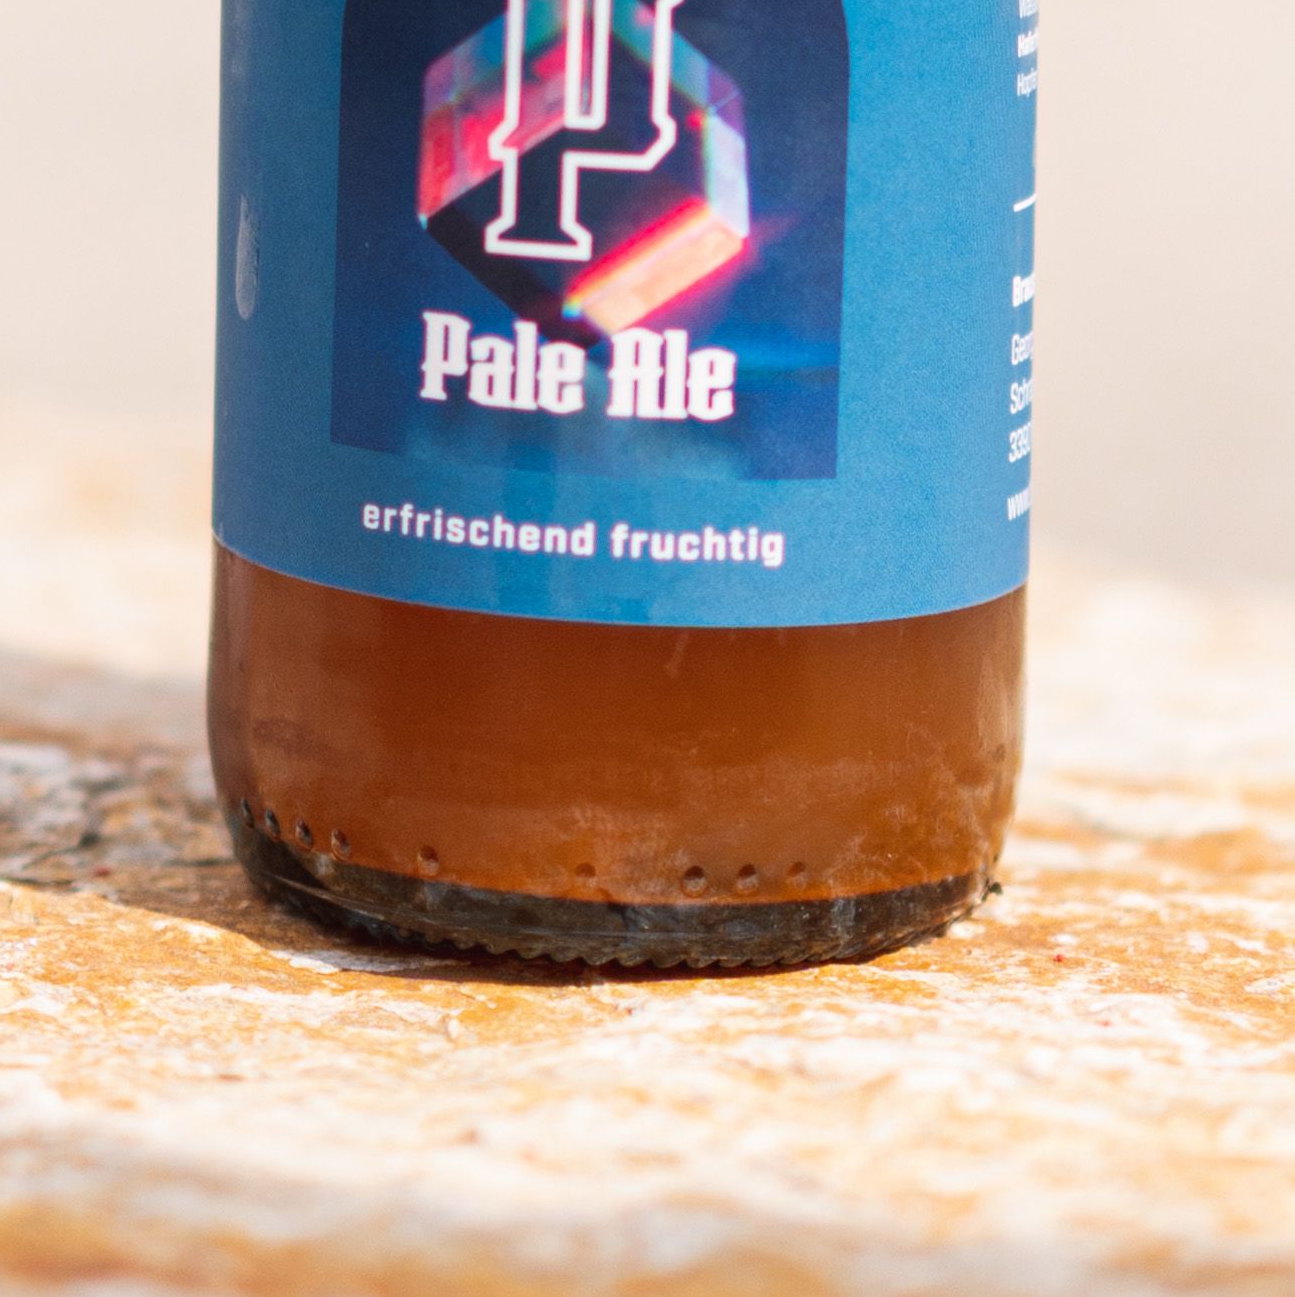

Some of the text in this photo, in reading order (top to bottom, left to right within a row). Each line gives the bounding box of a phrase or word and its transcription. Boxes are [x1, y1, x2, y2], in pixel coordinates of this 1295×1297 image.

[419, 310, 737, 421] Pale Ale
[362, 503, 786, 569] erfrischend fruchtig
